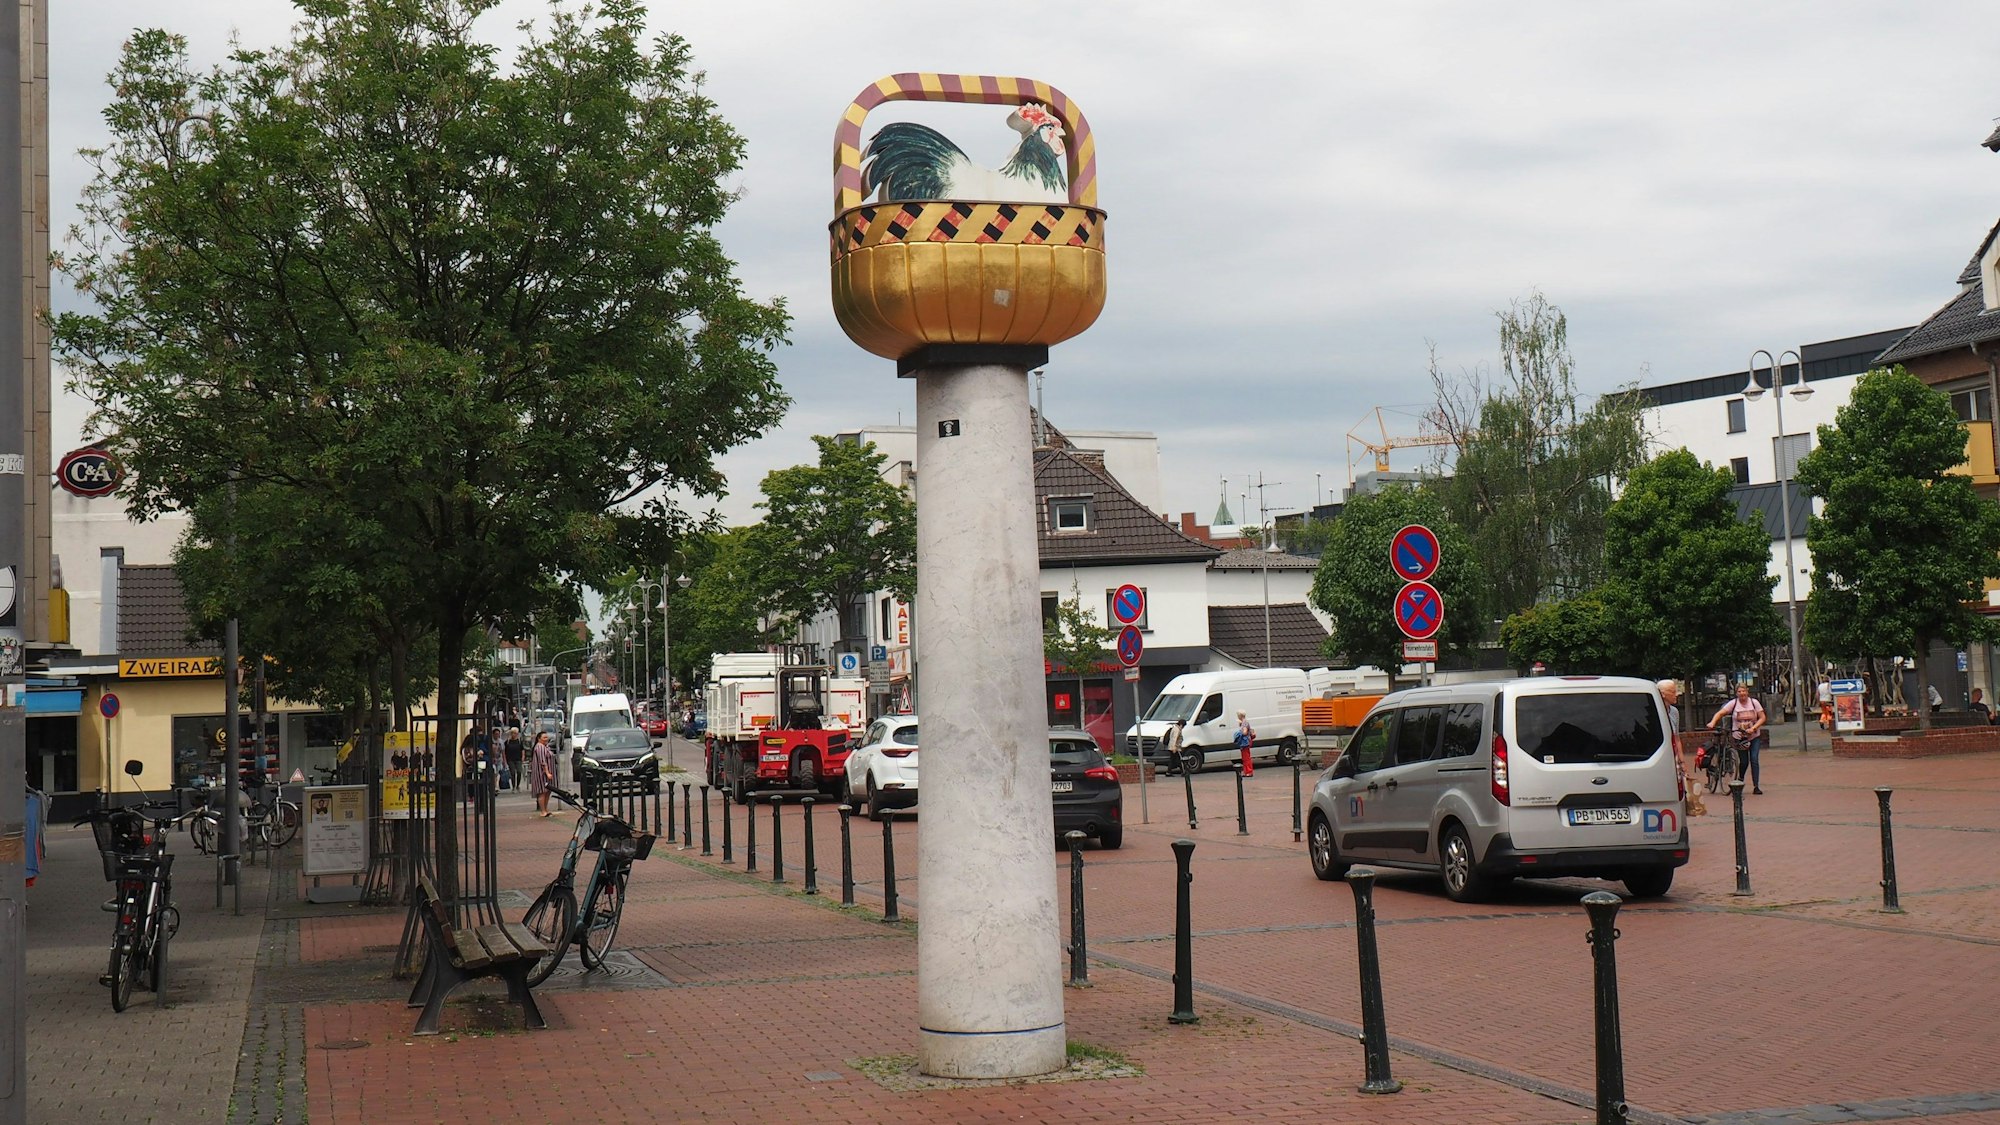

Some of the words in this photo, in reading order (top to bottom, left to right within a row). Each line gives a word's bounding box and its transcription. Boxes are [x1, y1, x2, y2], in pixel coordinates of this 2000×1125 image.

[71, 462, 112, 482] C&A
[874, 647, 882, 659] P
[1055, 782, 1071, 790] 2703
[1576, 810, 1589, 821] PB
[1596, 810, 1610, 821] DN
[1611, 809, 1629, 820] 563
